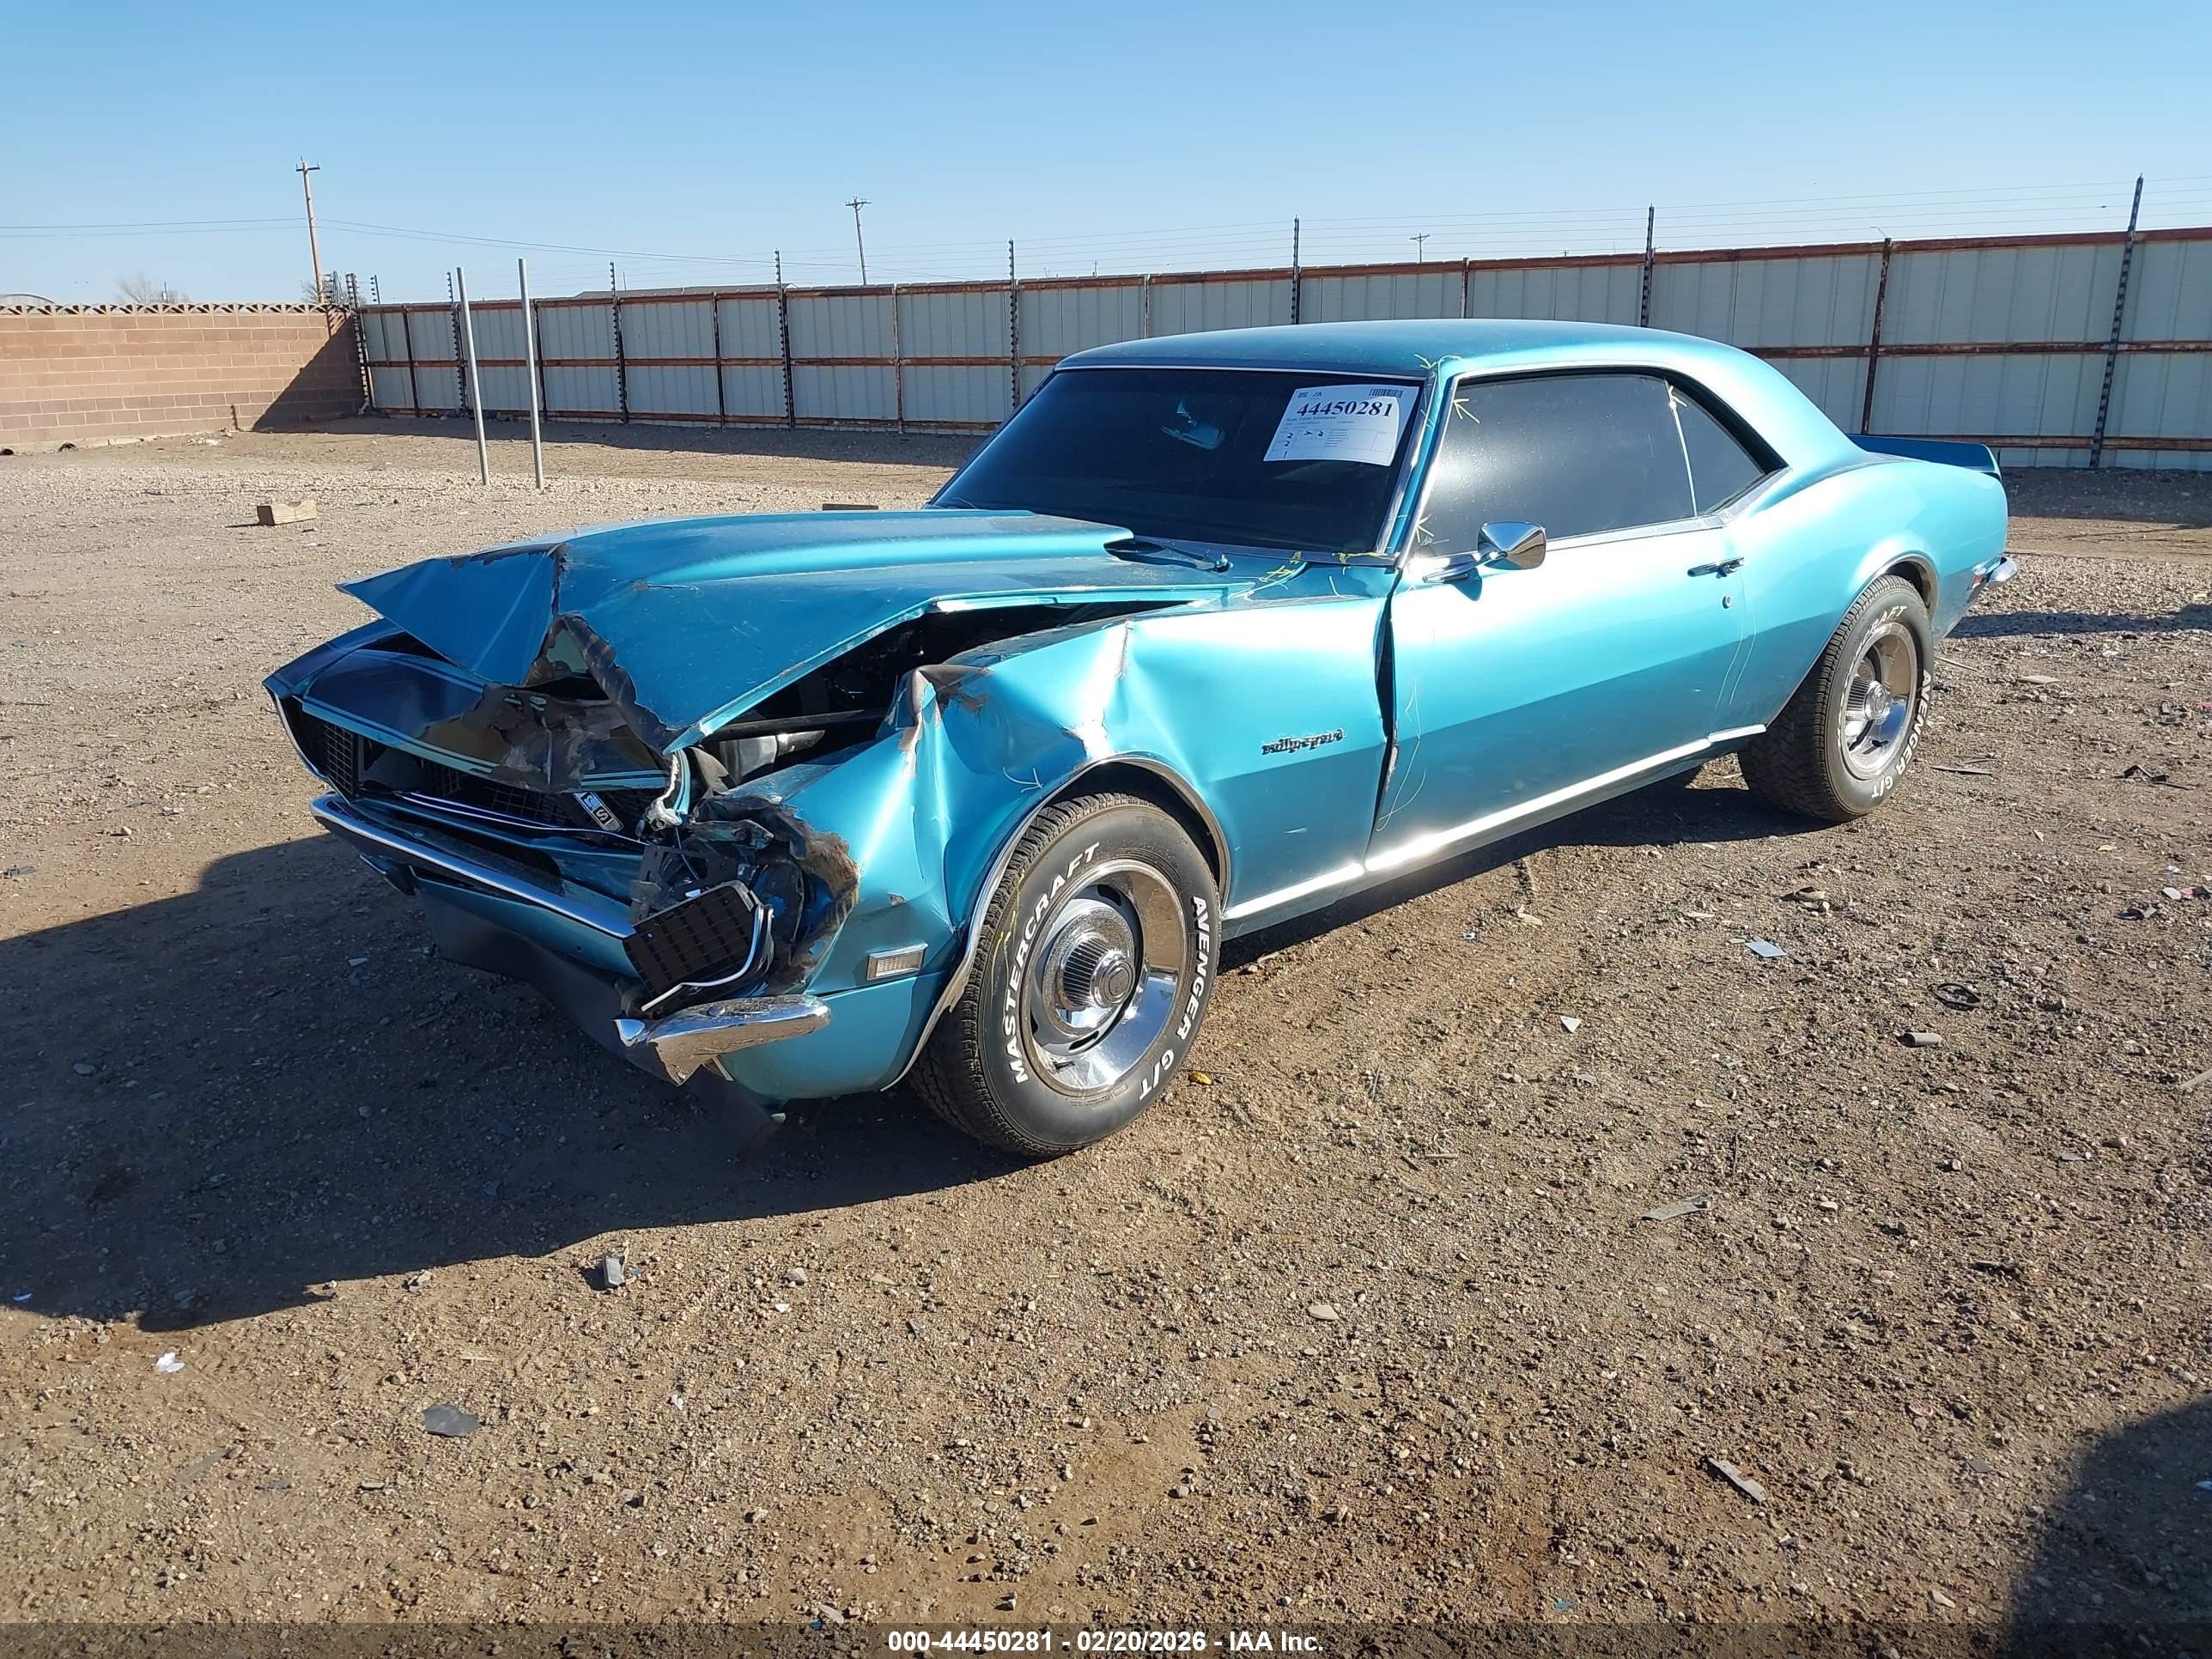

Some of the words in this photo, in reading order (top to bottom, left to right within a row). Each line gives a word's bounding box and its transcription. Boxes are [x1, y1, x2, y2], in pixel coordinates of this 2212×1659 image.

[1297, 400, 1394, 417] 44450281
[1894, 668, 1932, 775] AVENGER
[1870, 775, 1894, 799] G/T
[1004, 841, 1100, 1084] MASTERCRAFT
[1176, 895, 1211, 1041] AVENGER
[1139, 1048, 1176, 1101] G/T
